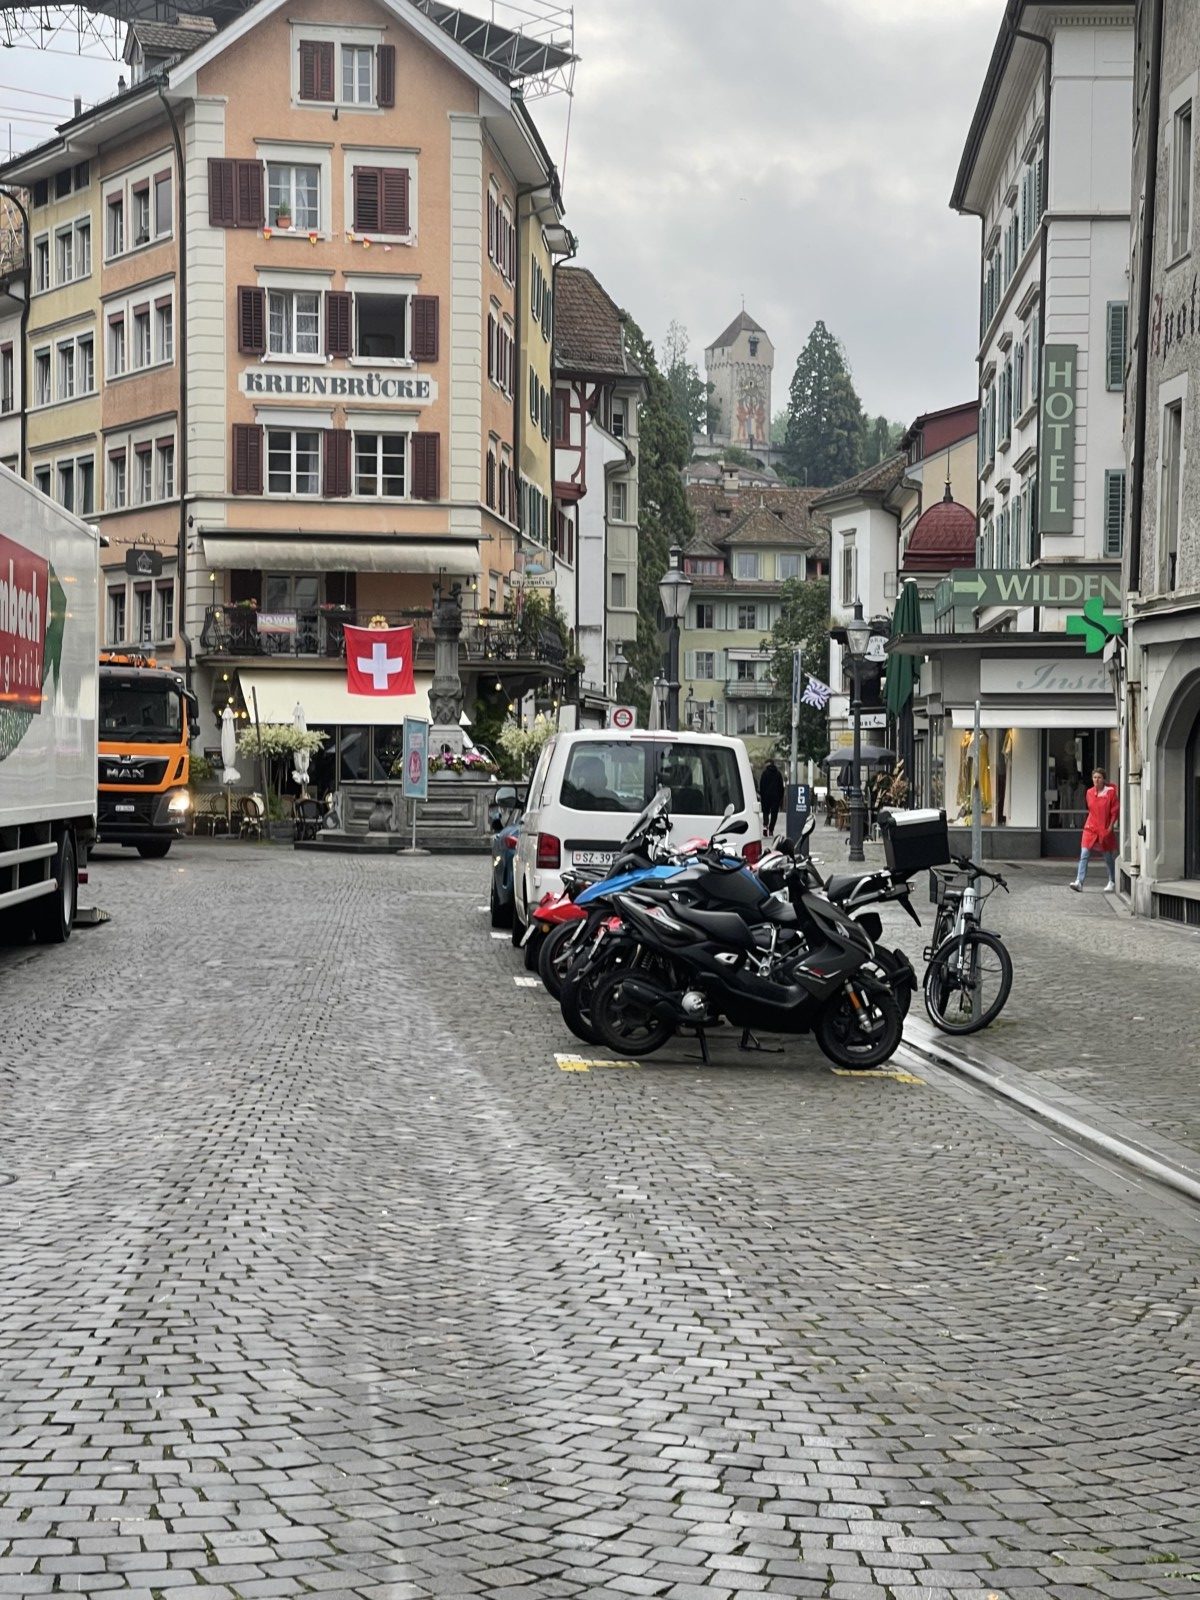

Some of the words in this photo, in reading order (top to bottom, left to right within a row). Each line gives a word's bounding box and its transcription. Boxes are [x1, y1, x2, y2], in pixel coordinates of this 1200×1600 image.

[1151, 273, 1200, 370] Apot
[245, 372, 430, 399] KRIENBRÜCKE
[1045, 361, 1074, 513] HOTEL
[258, 615, 273, 624] NO
[273, 615, 296, 625] WAR
[0, 645, 40, 694] gistik
[106, 768, 145, 778] MAN
